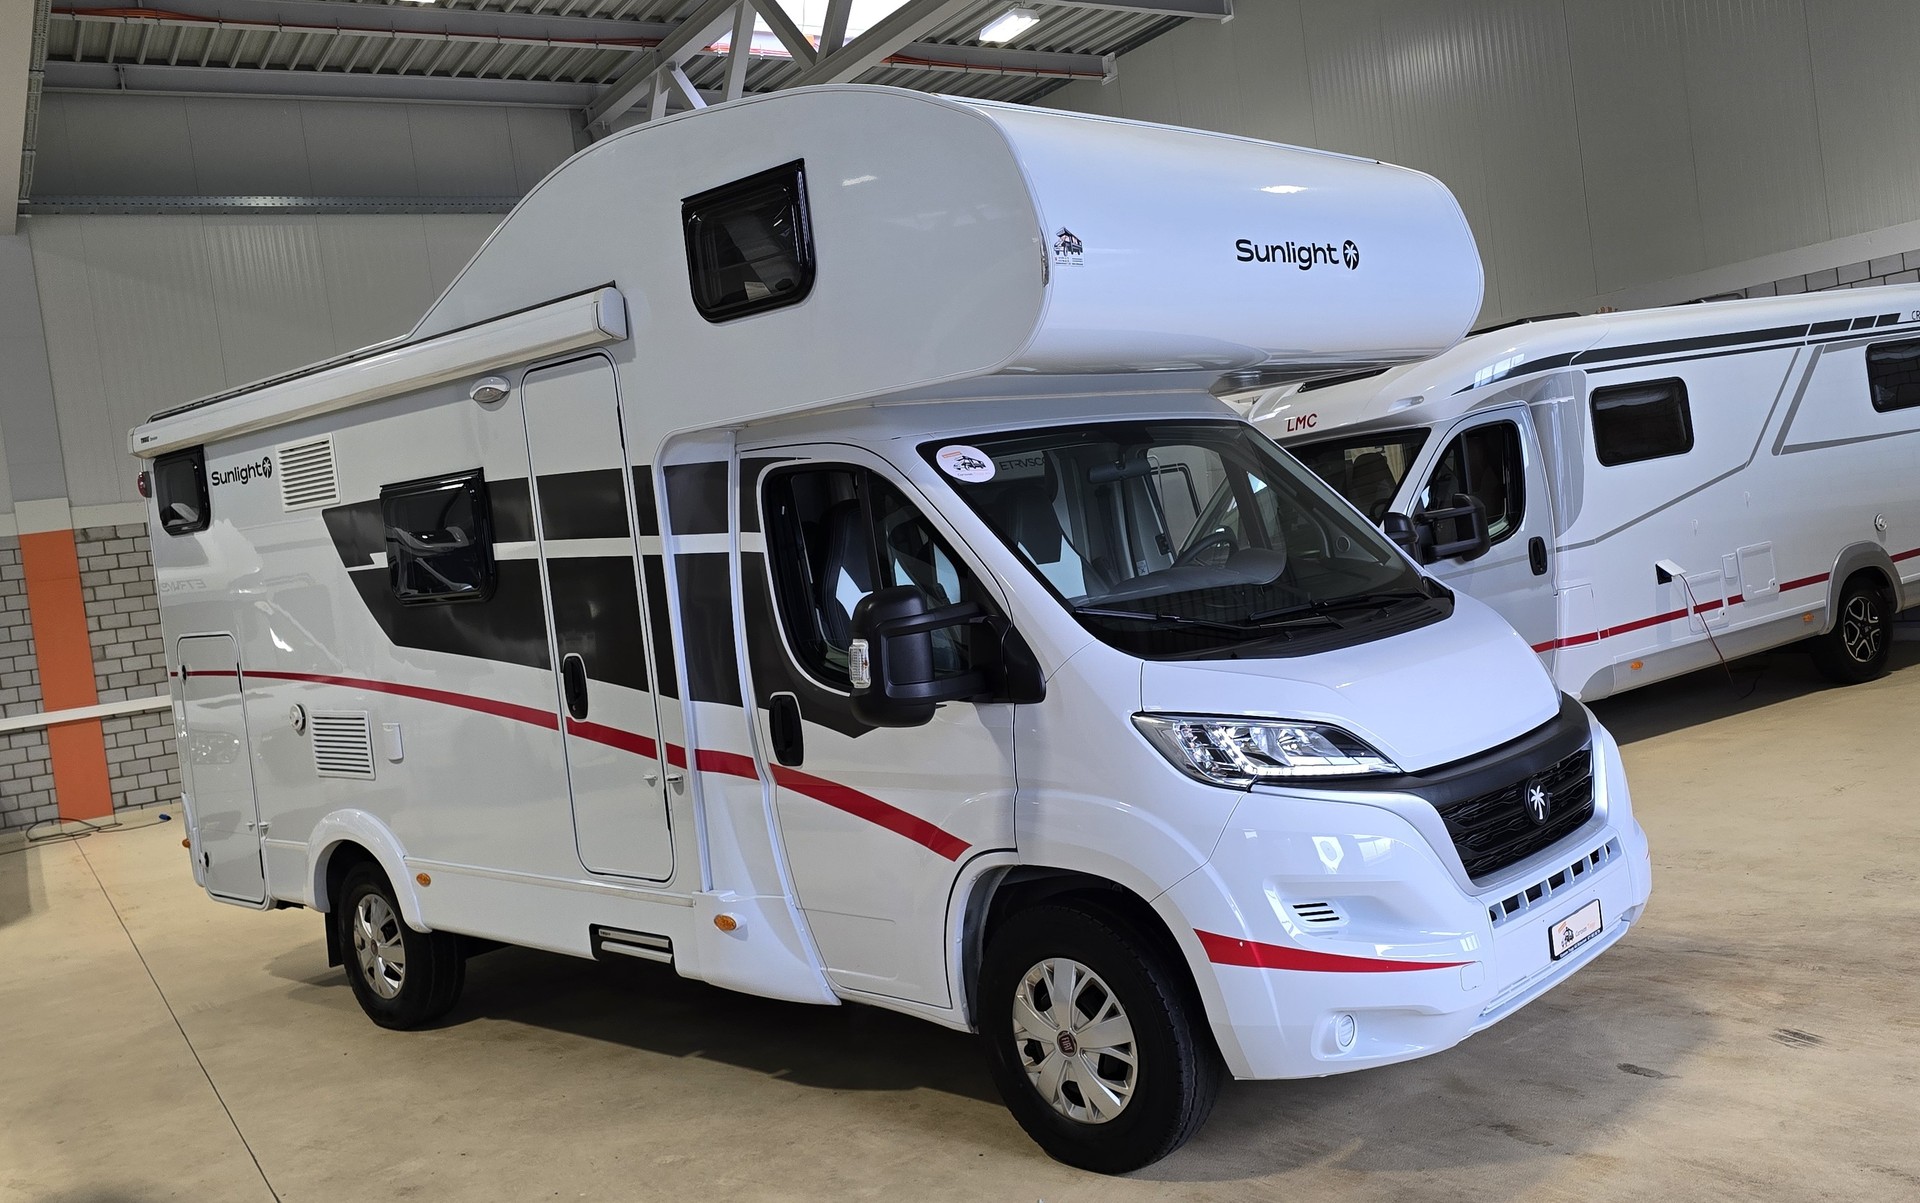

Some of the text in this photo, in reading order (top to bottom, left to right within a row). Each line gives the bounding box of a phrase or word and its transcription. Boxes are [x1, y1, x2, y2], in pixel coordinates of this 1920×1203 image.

[1235, 239, 1340, 270] Sunlight
[1287, 413, 1318, 432] LMC
[211, 462, 263, 486] Sunlight
